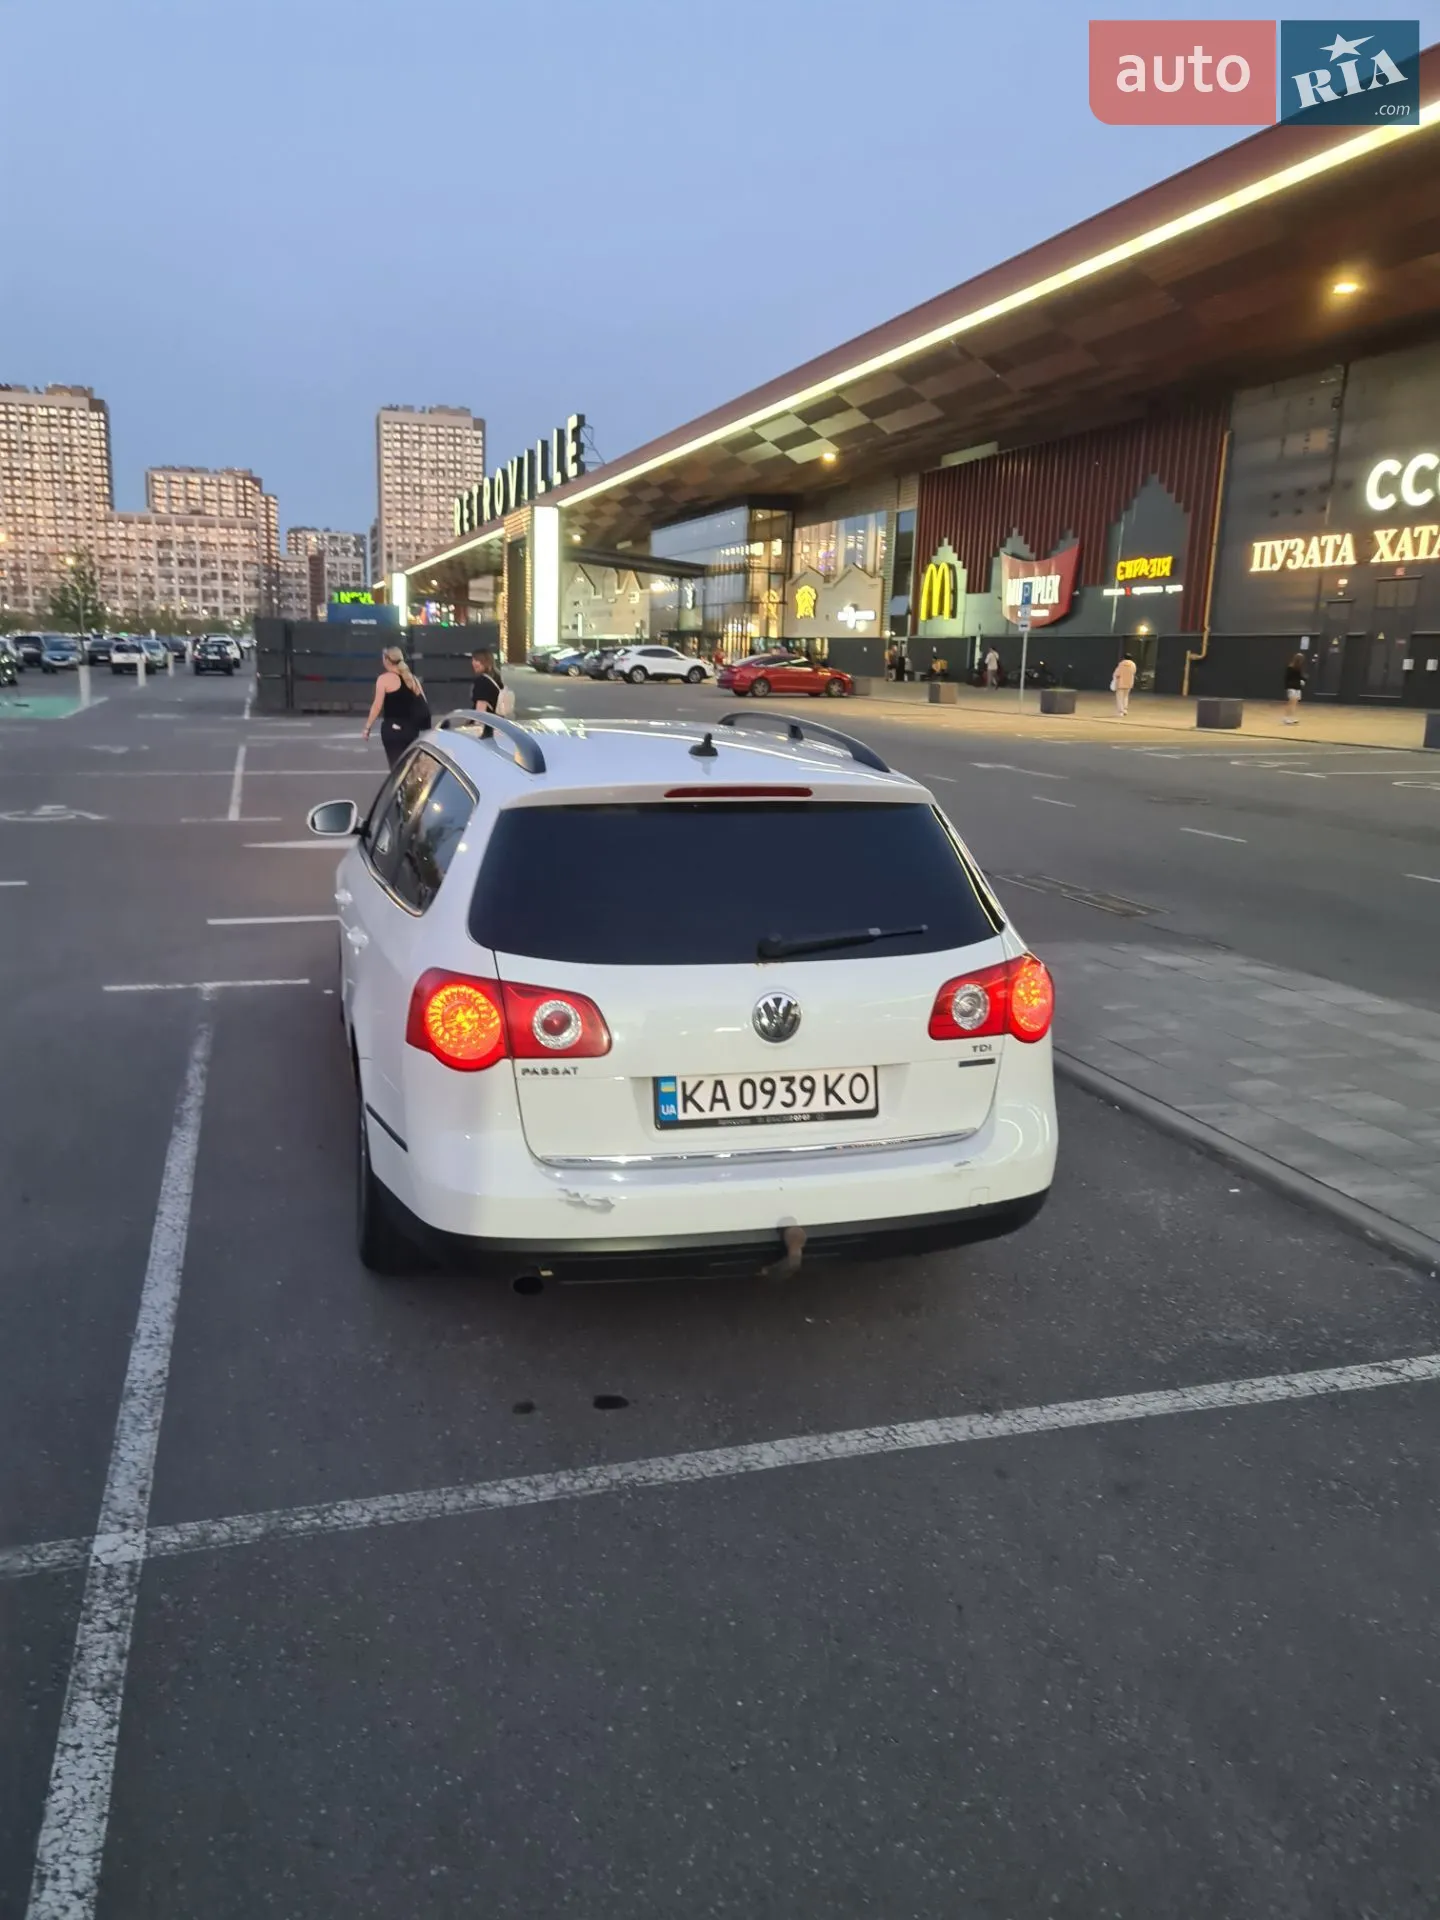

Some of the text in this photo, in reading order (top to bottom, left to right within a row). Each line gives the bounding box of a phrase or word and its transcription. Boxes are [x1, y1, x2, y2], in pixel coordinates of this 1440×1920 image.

[453, 413, 583, 537] RETROVILLE
[1366, 453, 1440, 511] CC
[1250, 532, 1357, 573] ПУЗАТА
[972, 1044, 992, 1052] TDI
[521, 1066, 579, 1076] PASSAT
[661, 1104, 677, 1115] UA
[681, 1072, 870, 1114] KA 0939 KO
